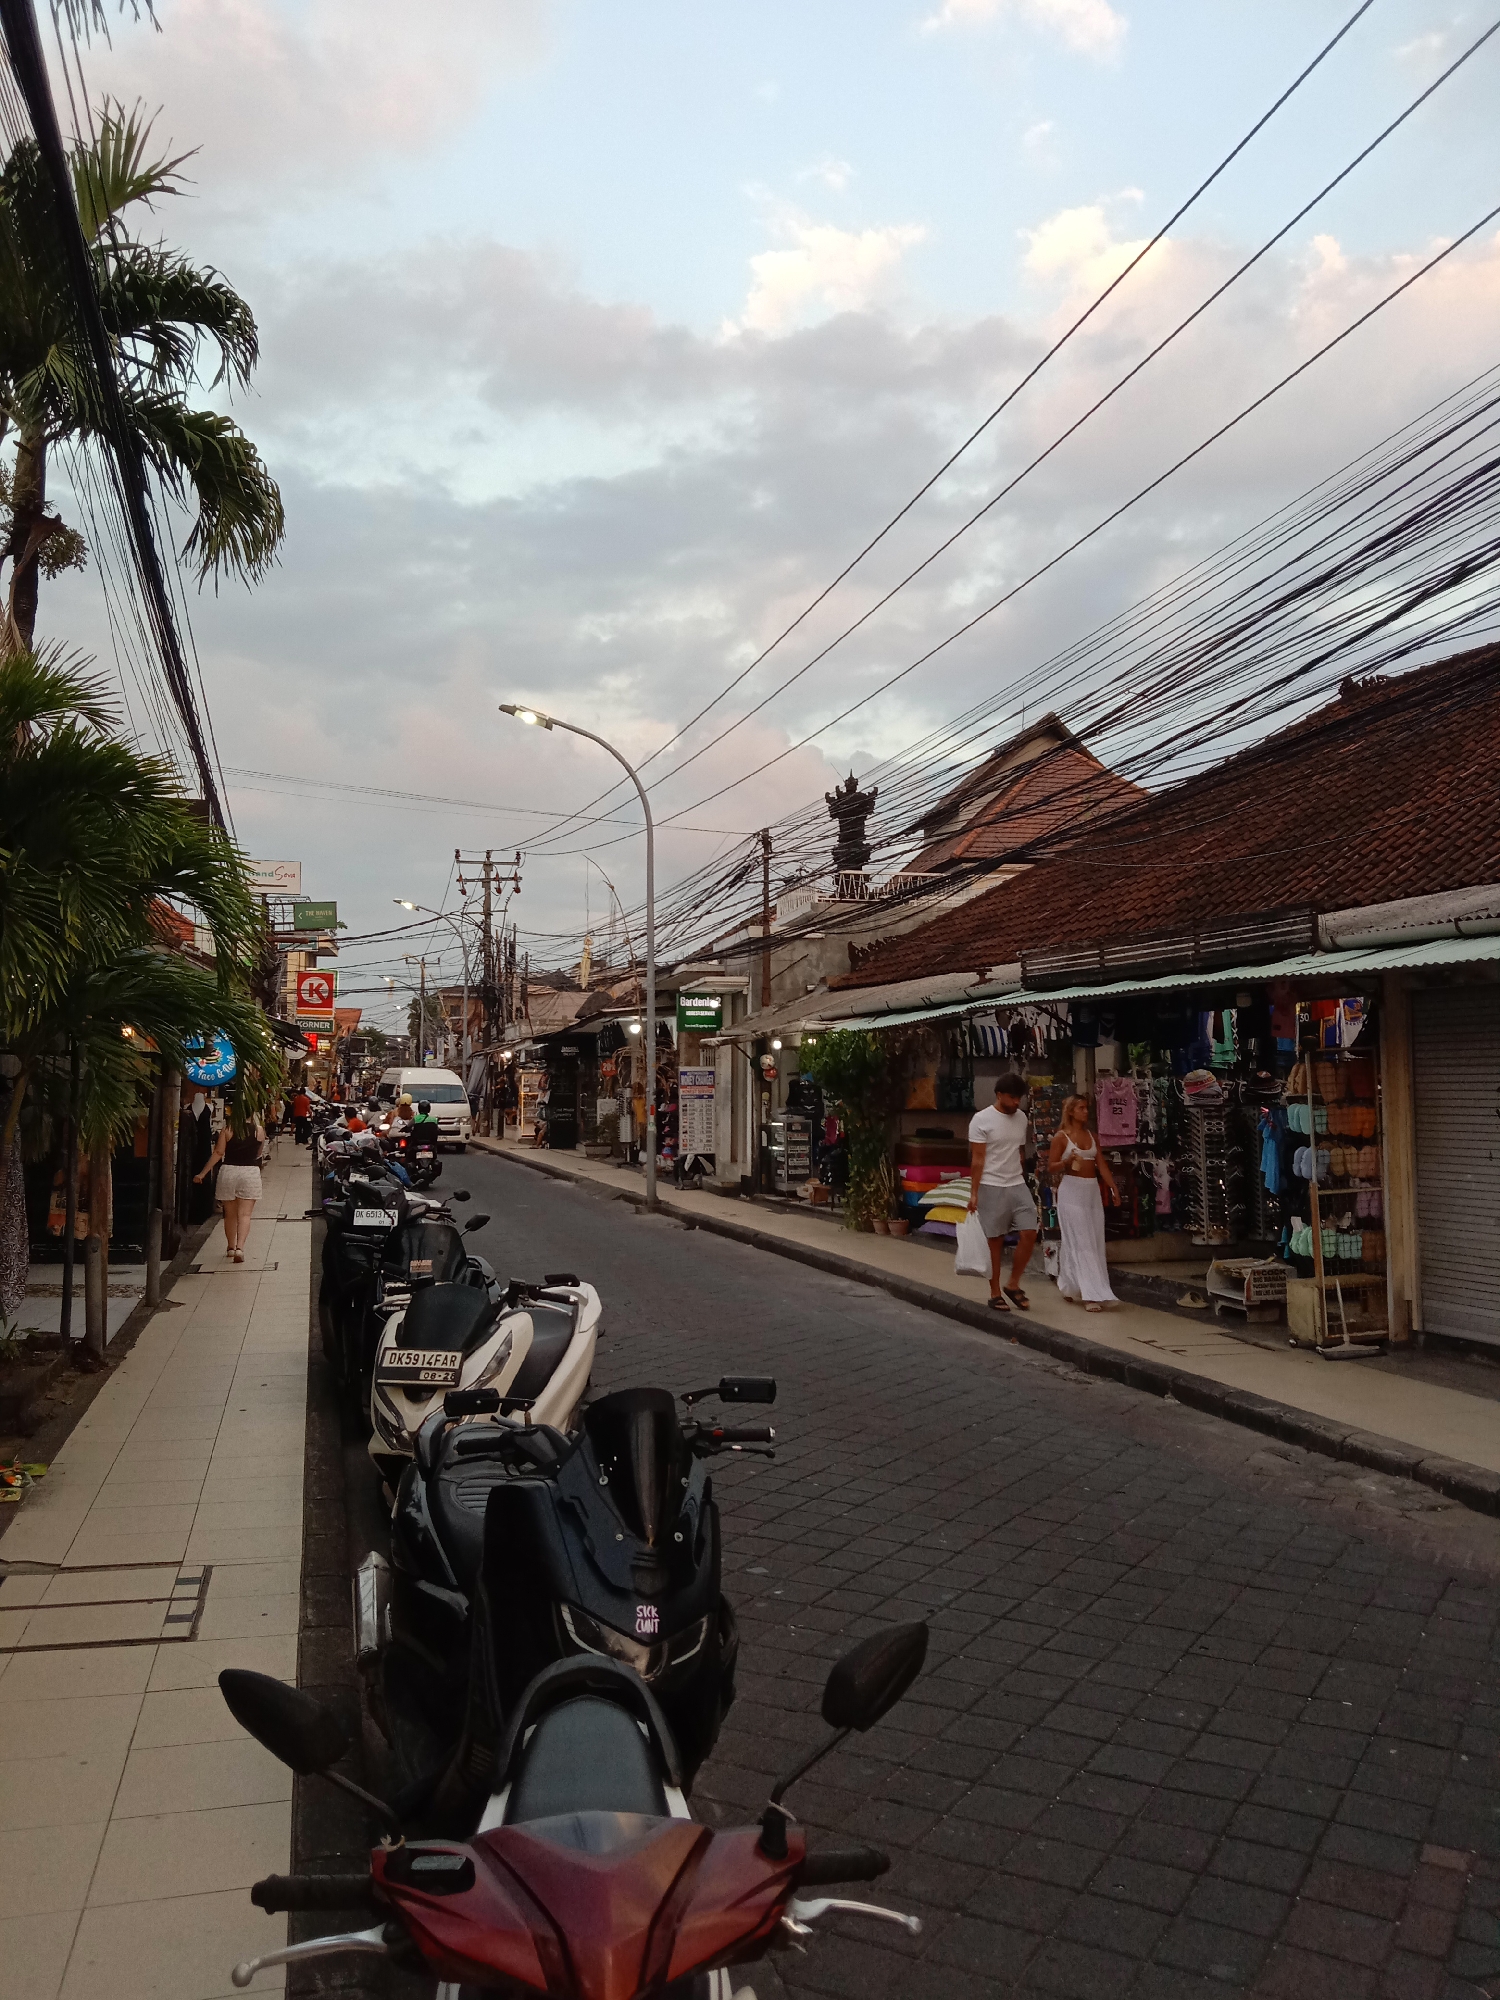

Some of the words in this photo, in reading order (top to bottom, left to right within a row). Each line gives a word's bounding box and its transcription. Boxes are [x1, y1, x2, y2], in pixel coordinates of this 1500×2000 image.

[1299, 1012, 1310, 1023] 30
[1108, 1098, 1127, 1106] BULLS
[1112, 1106, 1123, 1115] 23
[355, 1210, 364, 1218] DK
[365, 1210, 382, 1218] 6513
[1261, 1268, 1287, 1276] COCK
[636, 1604, 659, 1618] SICK
[635, 1618, 660, 1634] CUNT
